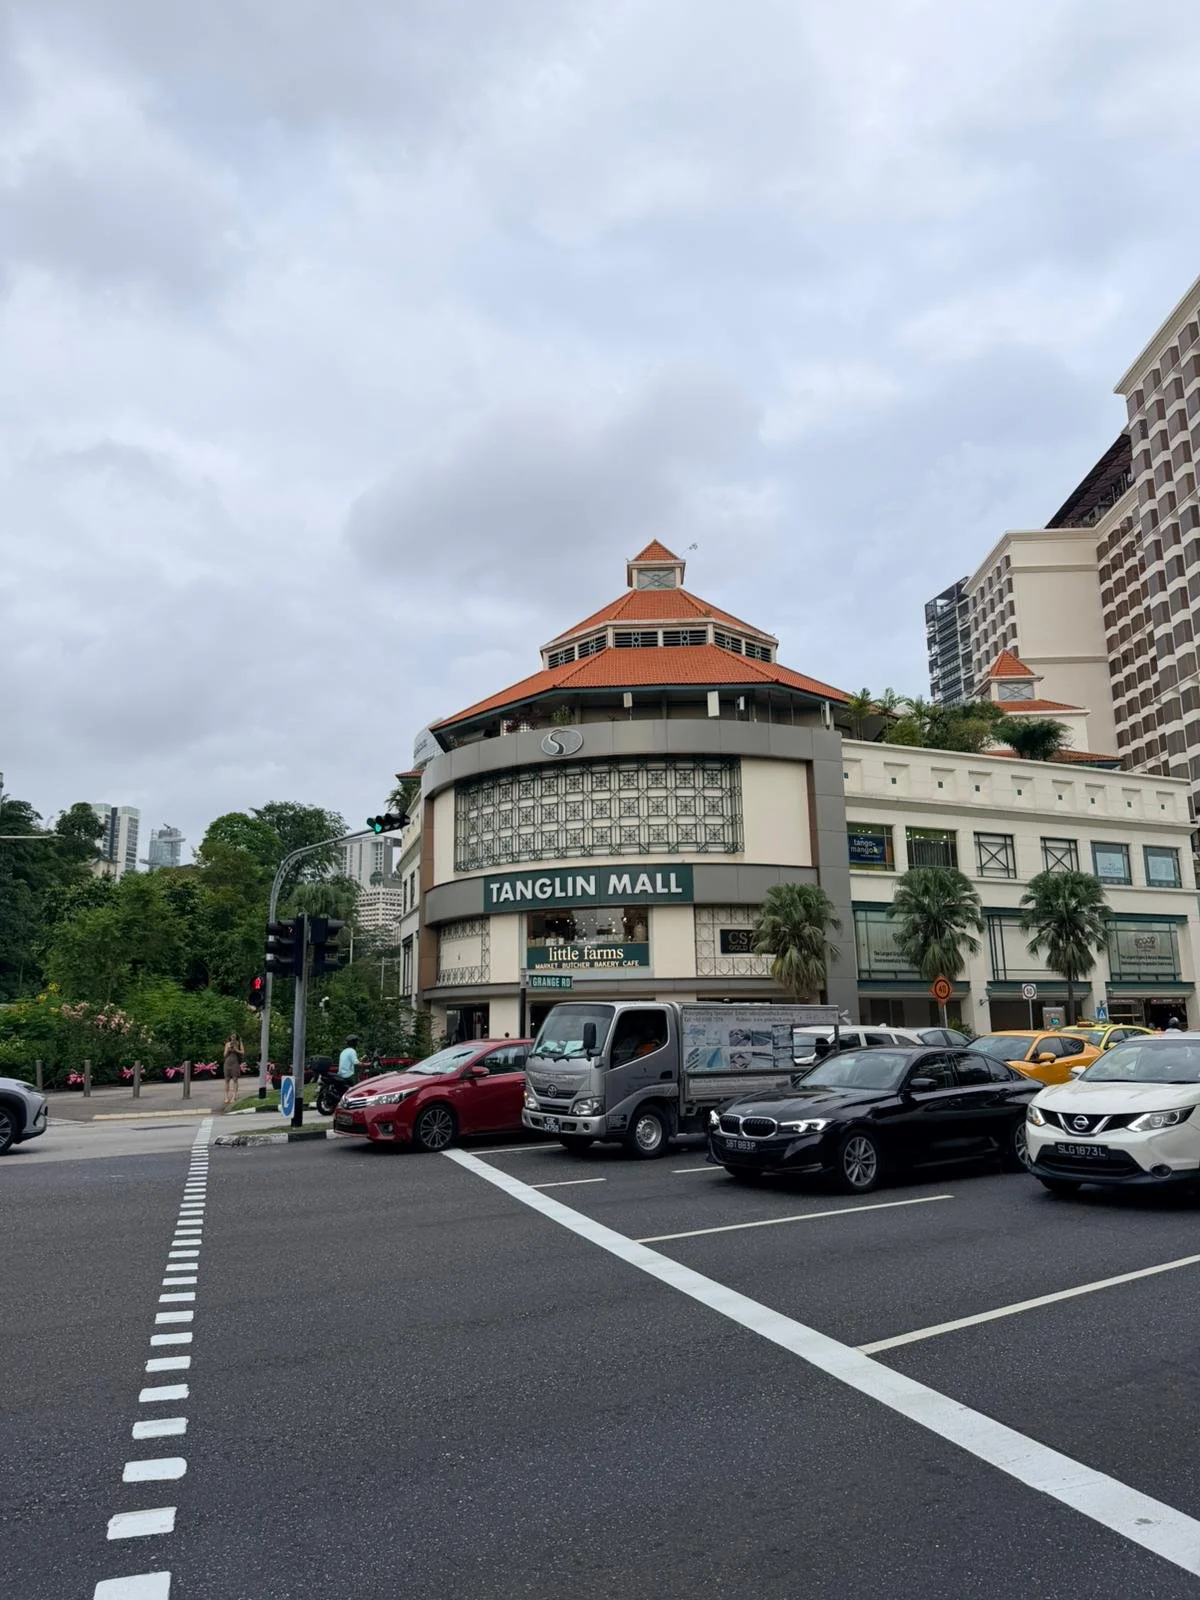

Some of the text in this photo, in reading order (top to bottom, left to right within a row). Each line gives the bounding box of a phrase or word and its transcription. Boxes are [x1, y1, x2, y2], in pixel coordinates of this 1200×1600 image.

[490, 872, 683, 903] TANGLIN MALL
[549, 945, 624, 961] little farms
[562, 961, 590, 969] BUTCHER
[594, 960, 619, 968] BAKERY
[532, 977, 571, 987] GRANGE RD
